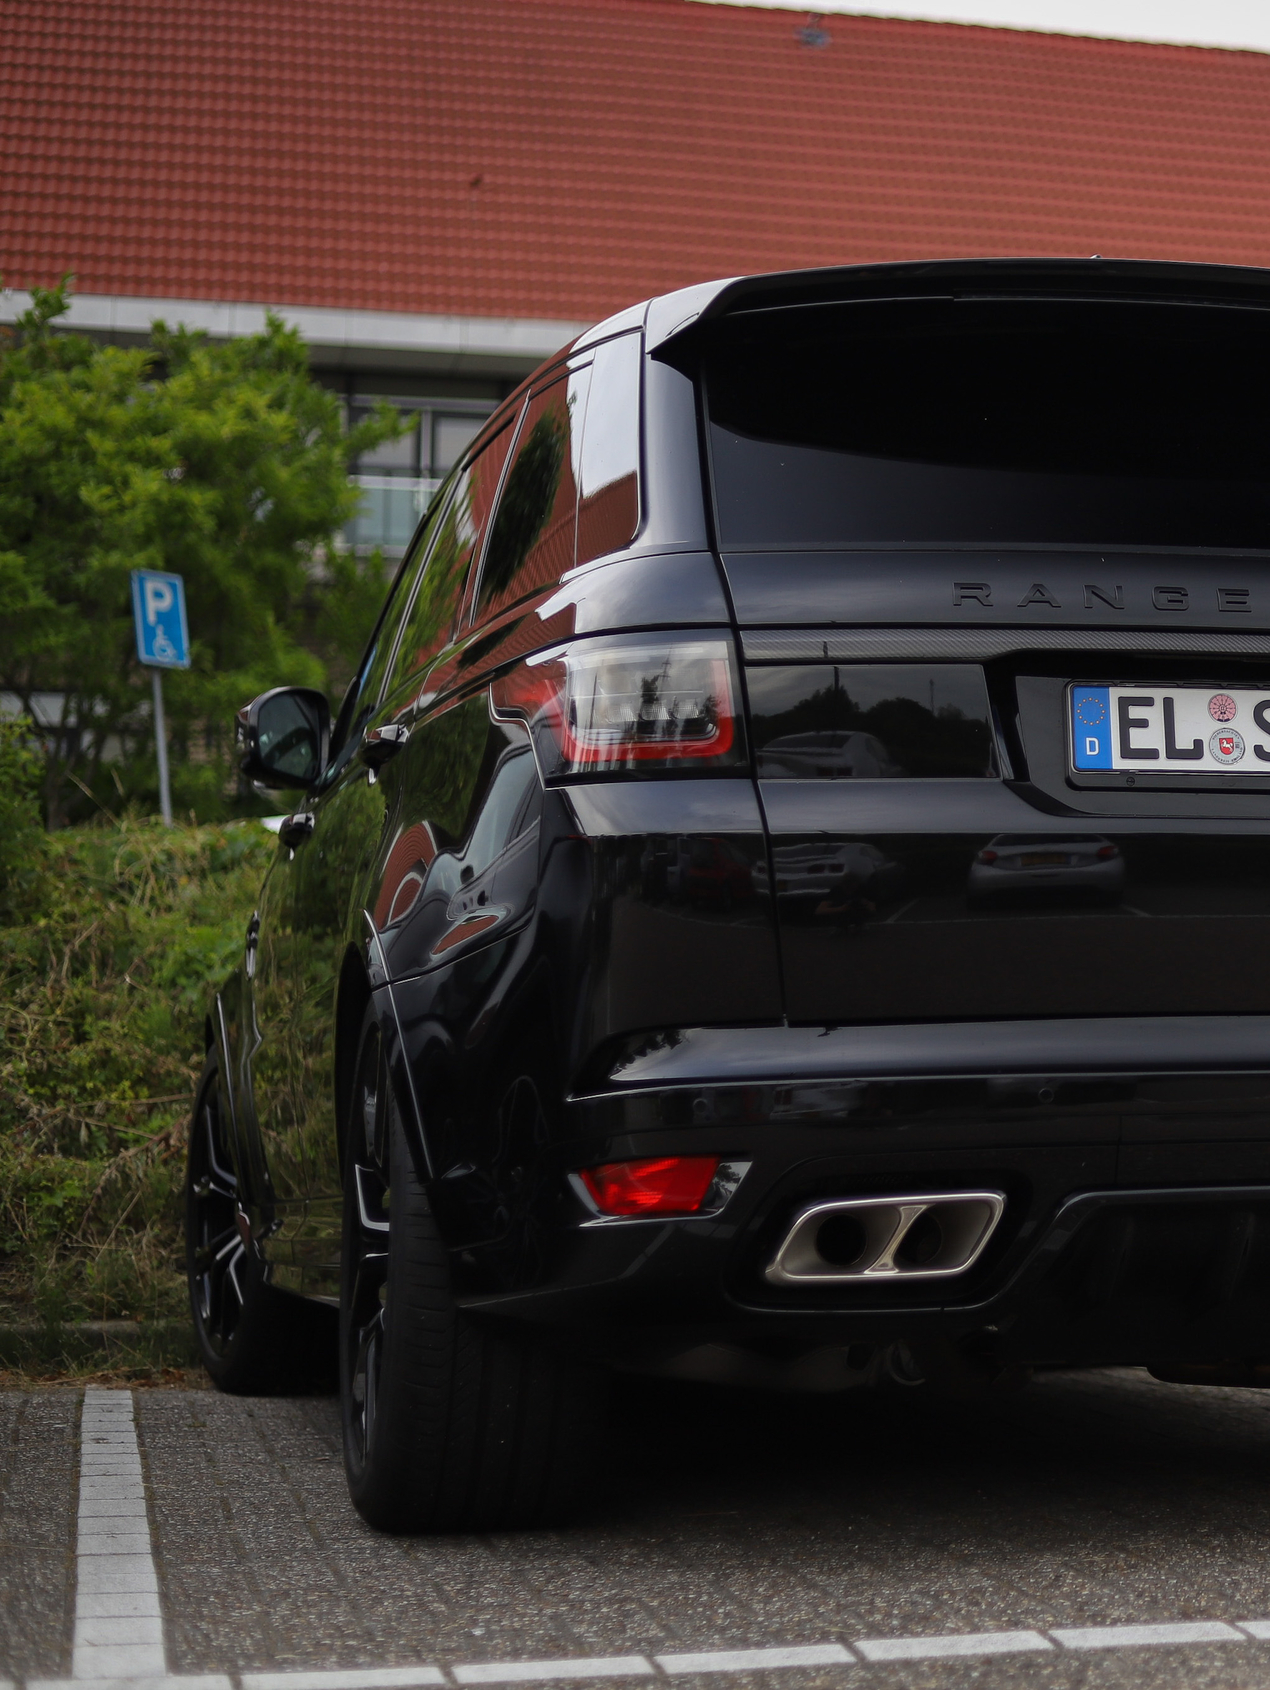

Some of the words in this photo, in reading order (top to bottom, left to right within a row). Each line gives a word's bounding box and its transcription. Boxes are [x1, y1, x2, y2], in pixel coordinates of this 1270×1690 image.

[144, 579, 174, 627] P
[953, 582, 1252, 613] RANGE
[1086, 737, 1099, 755] D
[1118, 696, 1204, 760] EL
